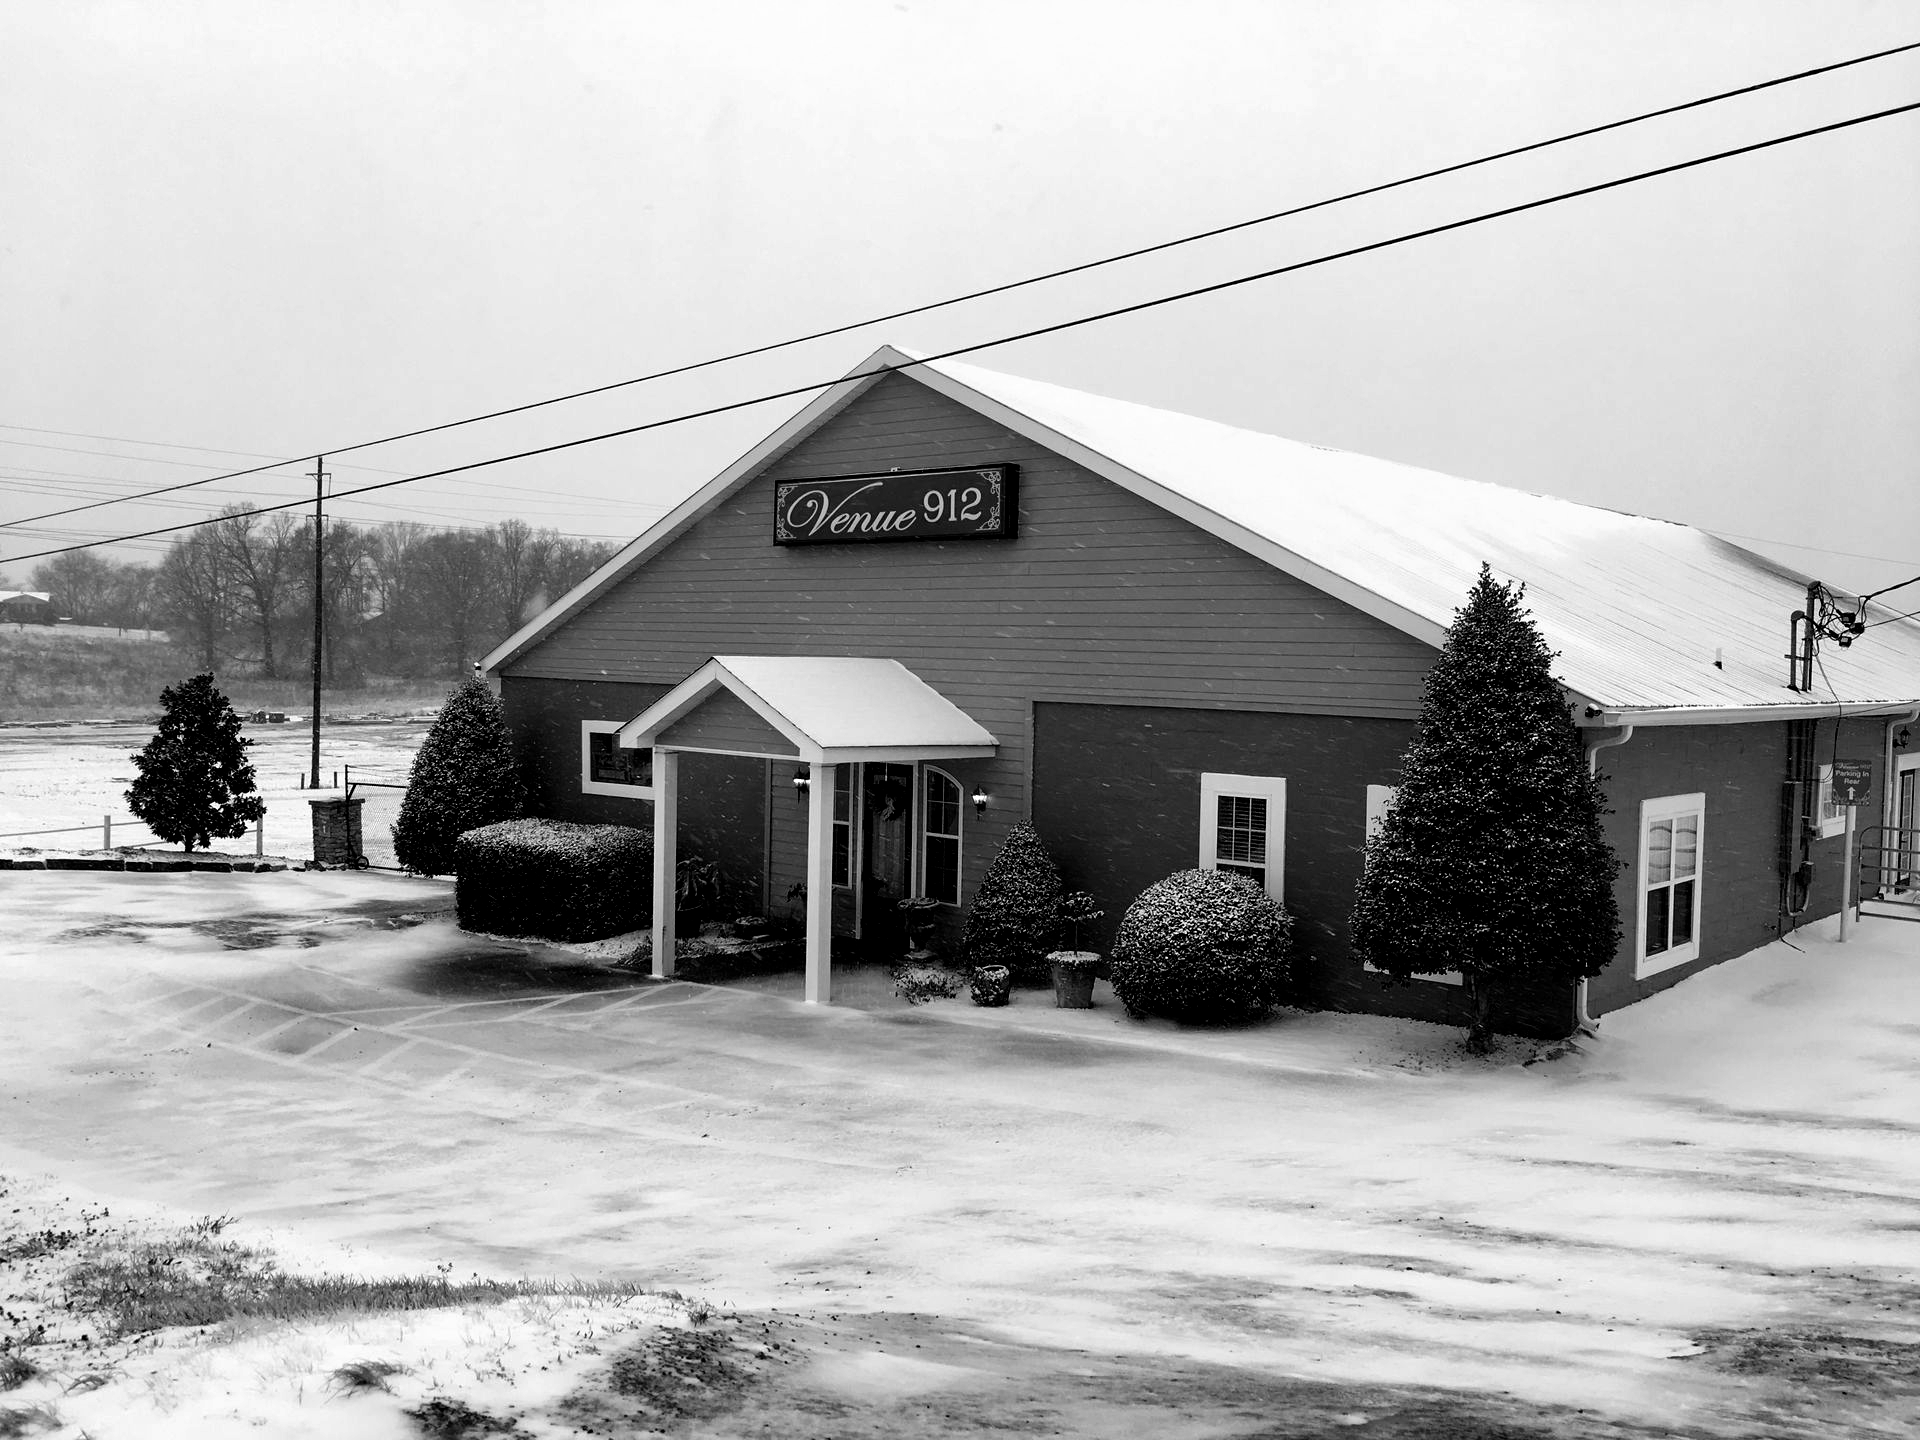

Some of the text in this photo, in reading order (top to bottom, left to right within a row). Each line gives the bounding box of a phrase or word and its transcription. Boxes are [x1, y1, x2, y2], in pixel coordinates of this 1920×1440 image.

[787, 482, 982, 536] Venue 912
[1835, 770, 1861, 778] Parking
[1843, 777, 1861, 785] Rear
